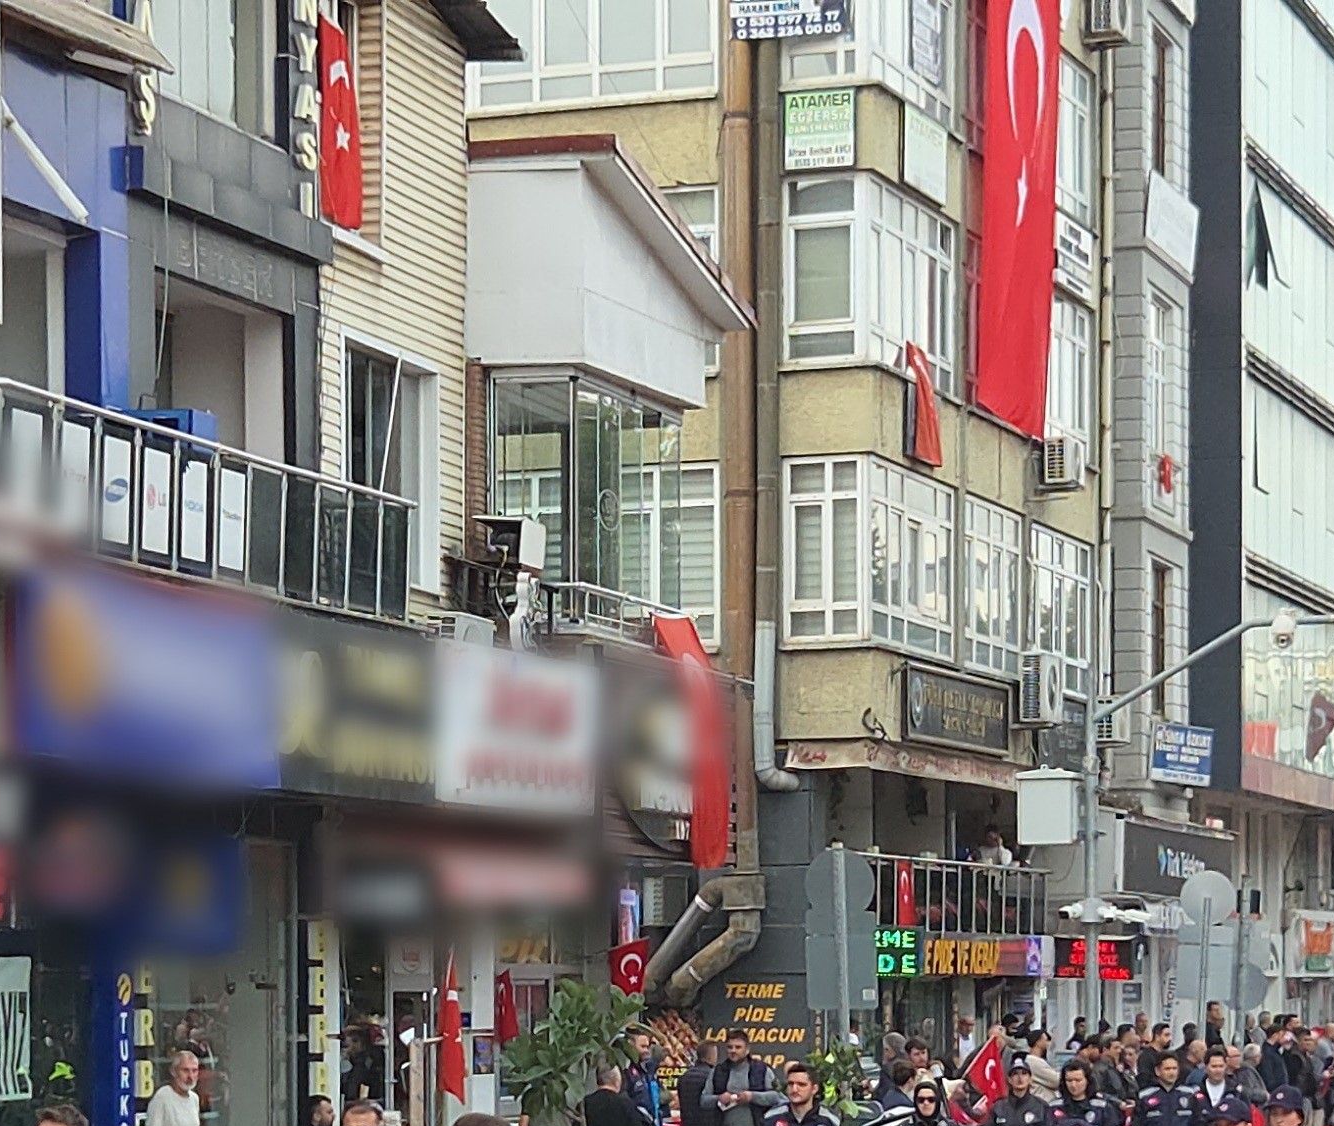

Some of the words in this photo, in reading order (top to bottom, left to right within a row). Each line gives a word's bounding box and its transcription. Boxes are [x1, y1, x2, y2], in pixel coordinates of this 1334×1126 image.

[824, 10, 840, 21] 17
[788, 93, 852, 109] ATAMER
[725, 983, 785, 999] TERME
[733, 1004, 776, 1023] PİDE
[705, 1027, 805, 1043] LAMACUN
